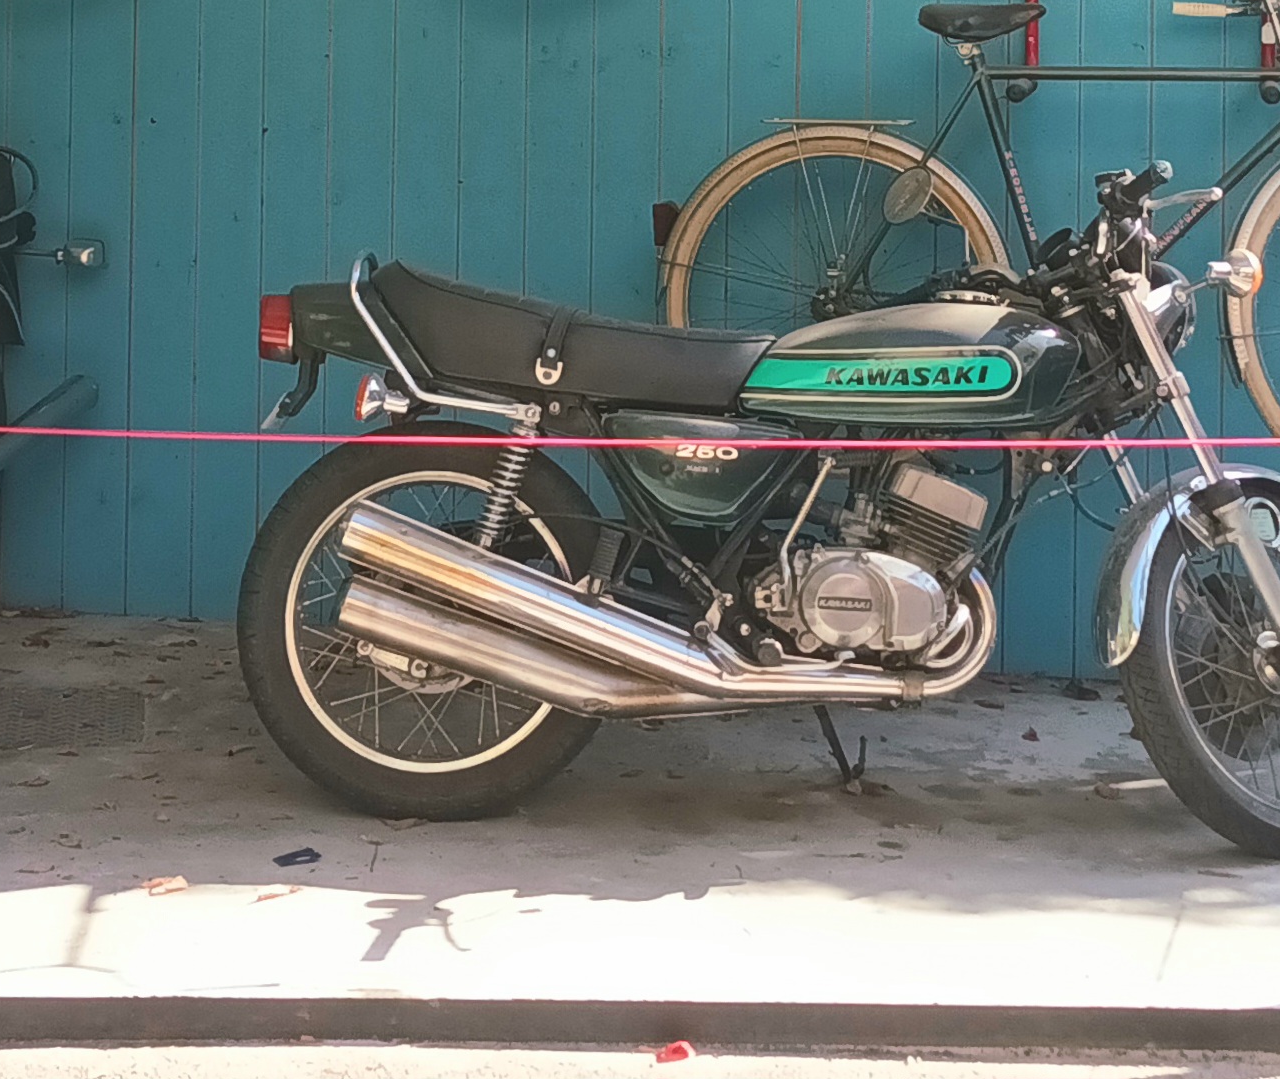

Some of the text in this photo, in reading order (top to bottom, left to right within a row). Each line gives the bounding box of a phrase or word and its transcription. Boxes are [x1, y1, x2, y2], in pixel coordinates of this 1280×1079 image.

[824, 365, 989, 387] KAWASAKI
[675, 443, 739, 461] 250
[818, 599, 871, 609] KAWASAKI
